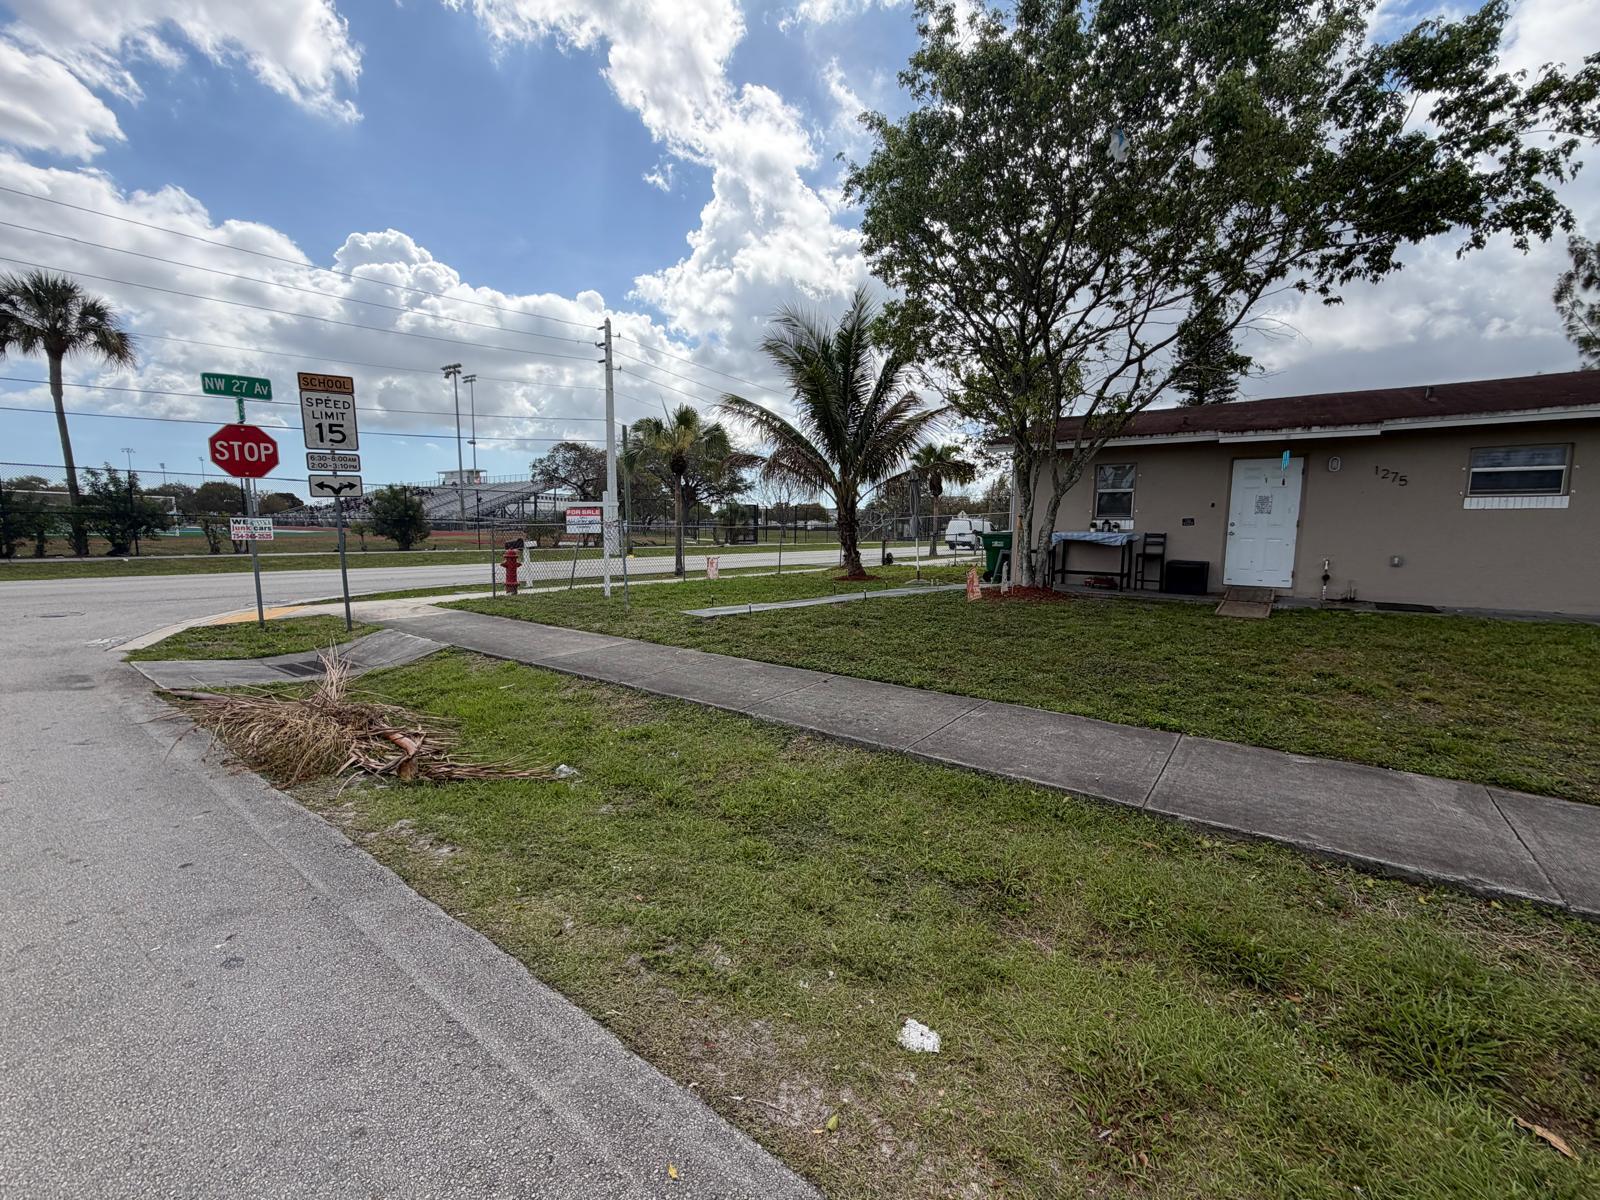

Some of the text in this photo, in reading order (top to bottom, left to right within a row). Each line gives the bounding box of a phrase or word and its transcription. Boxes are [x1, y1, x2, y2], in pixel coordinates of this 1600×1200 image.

[204, 376, 269, 396] NW 27 Av
[302, 376, 351, 390] SCHOOL
[305, 397, 351, 410] SPEED
[312, 410, 346, 421] LIMIT
[315, 422, 347, 444] 15
[215, 440, 274, 462] STOP
[1375, 465, 1409, 487] 1275
